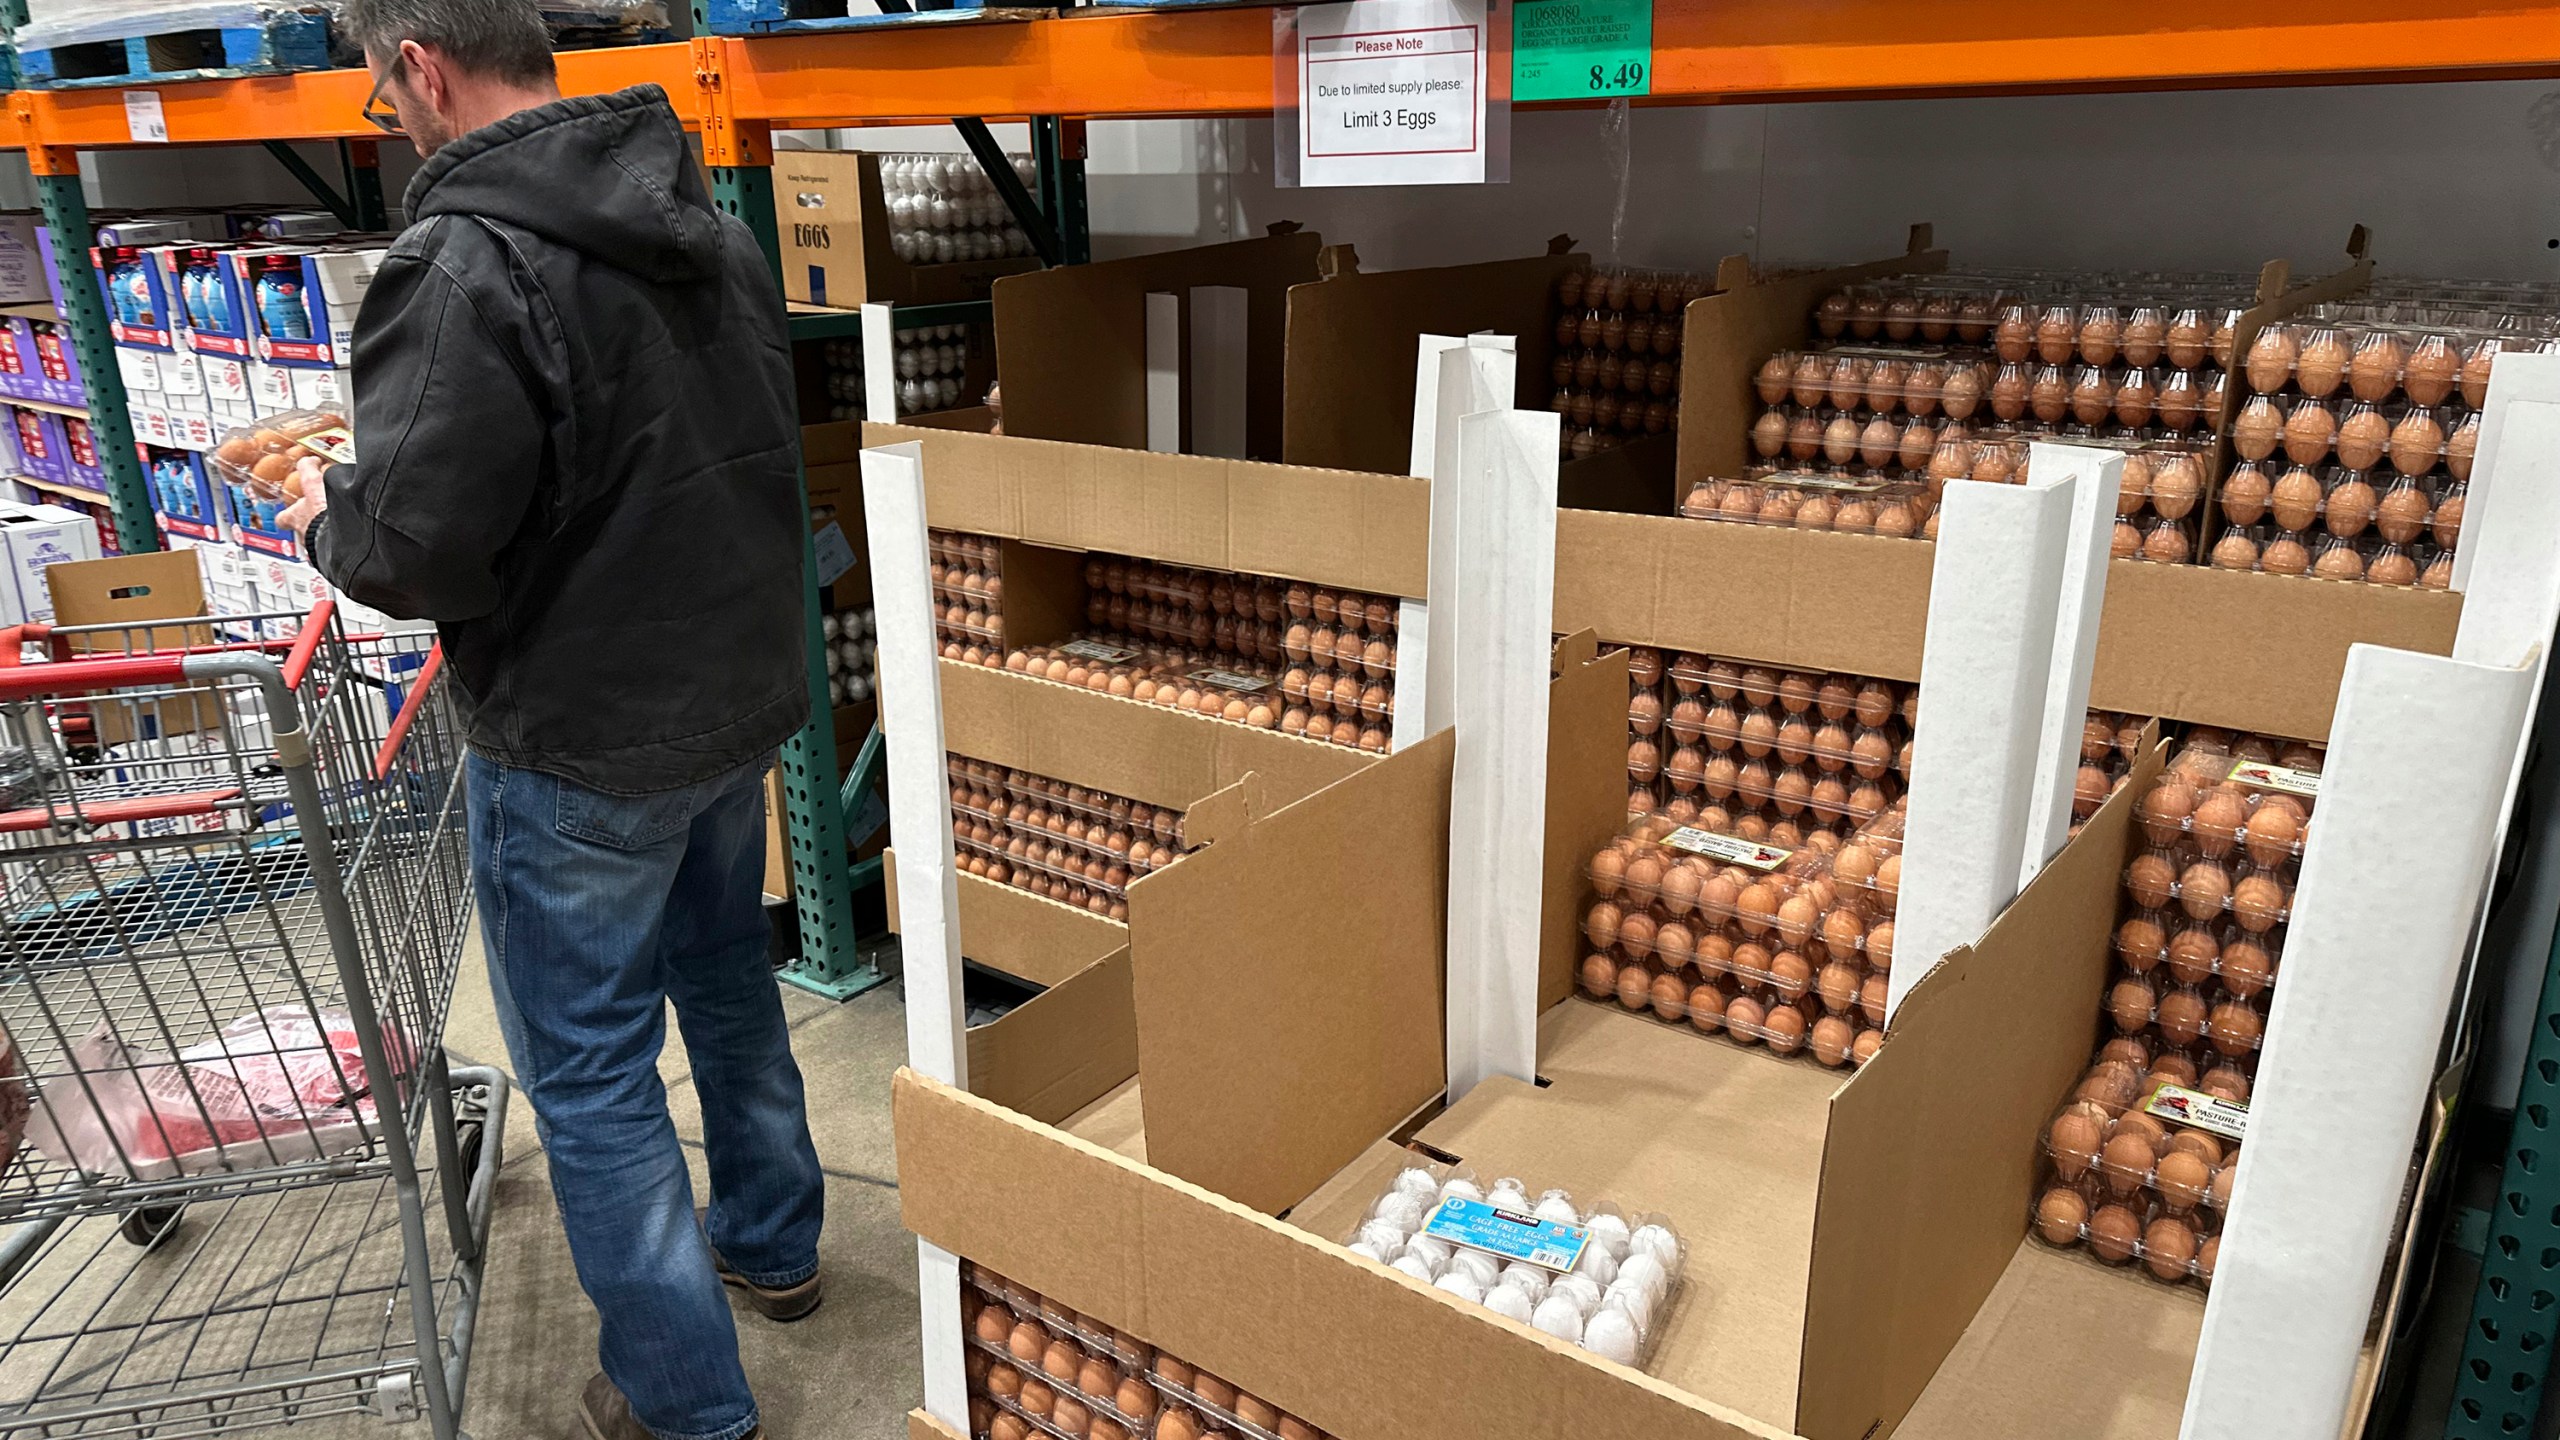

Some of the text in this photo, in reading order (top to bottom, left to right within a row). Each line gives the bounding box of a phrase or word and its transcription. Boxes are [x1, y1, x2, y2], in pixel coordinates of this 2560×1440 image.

[1530, 5, 1580, 20] 1068080
[1522, 15, 1614, 28] KIRKLAND SIGNATURE
[1521, 23, 1631, 38] ORGANIC PASTURE RAISED
[1356, 38, 1424, 53] Please Note
[1521, 38, 1540, 48] EGG
[1561, 35, 1590, 46] LARGE
[1592, 34, 1620, 43] GRADE
[1622, 32, 1629, 41] A
[1521, 70, 1541, 79] 4.245
[1589, 62, 1643, 90] 8.49
[1318, 78, 1464, 97] Due to limited supply please:
[1344, 109, 1436, 130] Limit 3 Eggs
[794, 223, 830, 249] EGGS
[2195, 1108, 2247, 1128] PASTURE-R
[1496, 1210, 1539, 1224] KIRKLAND
[1468, 1214, 1494, 1227] CAGE
[1497, 1222, 1519, 1234] FREE
[1524, 1230, 1550, 1242] EGGS
[1471, 1224, 1499, 1236] GRADE
[1512, 1236, 1538, 1247] LARGE
[1498, 1240, 1520, 1250] EGGS
